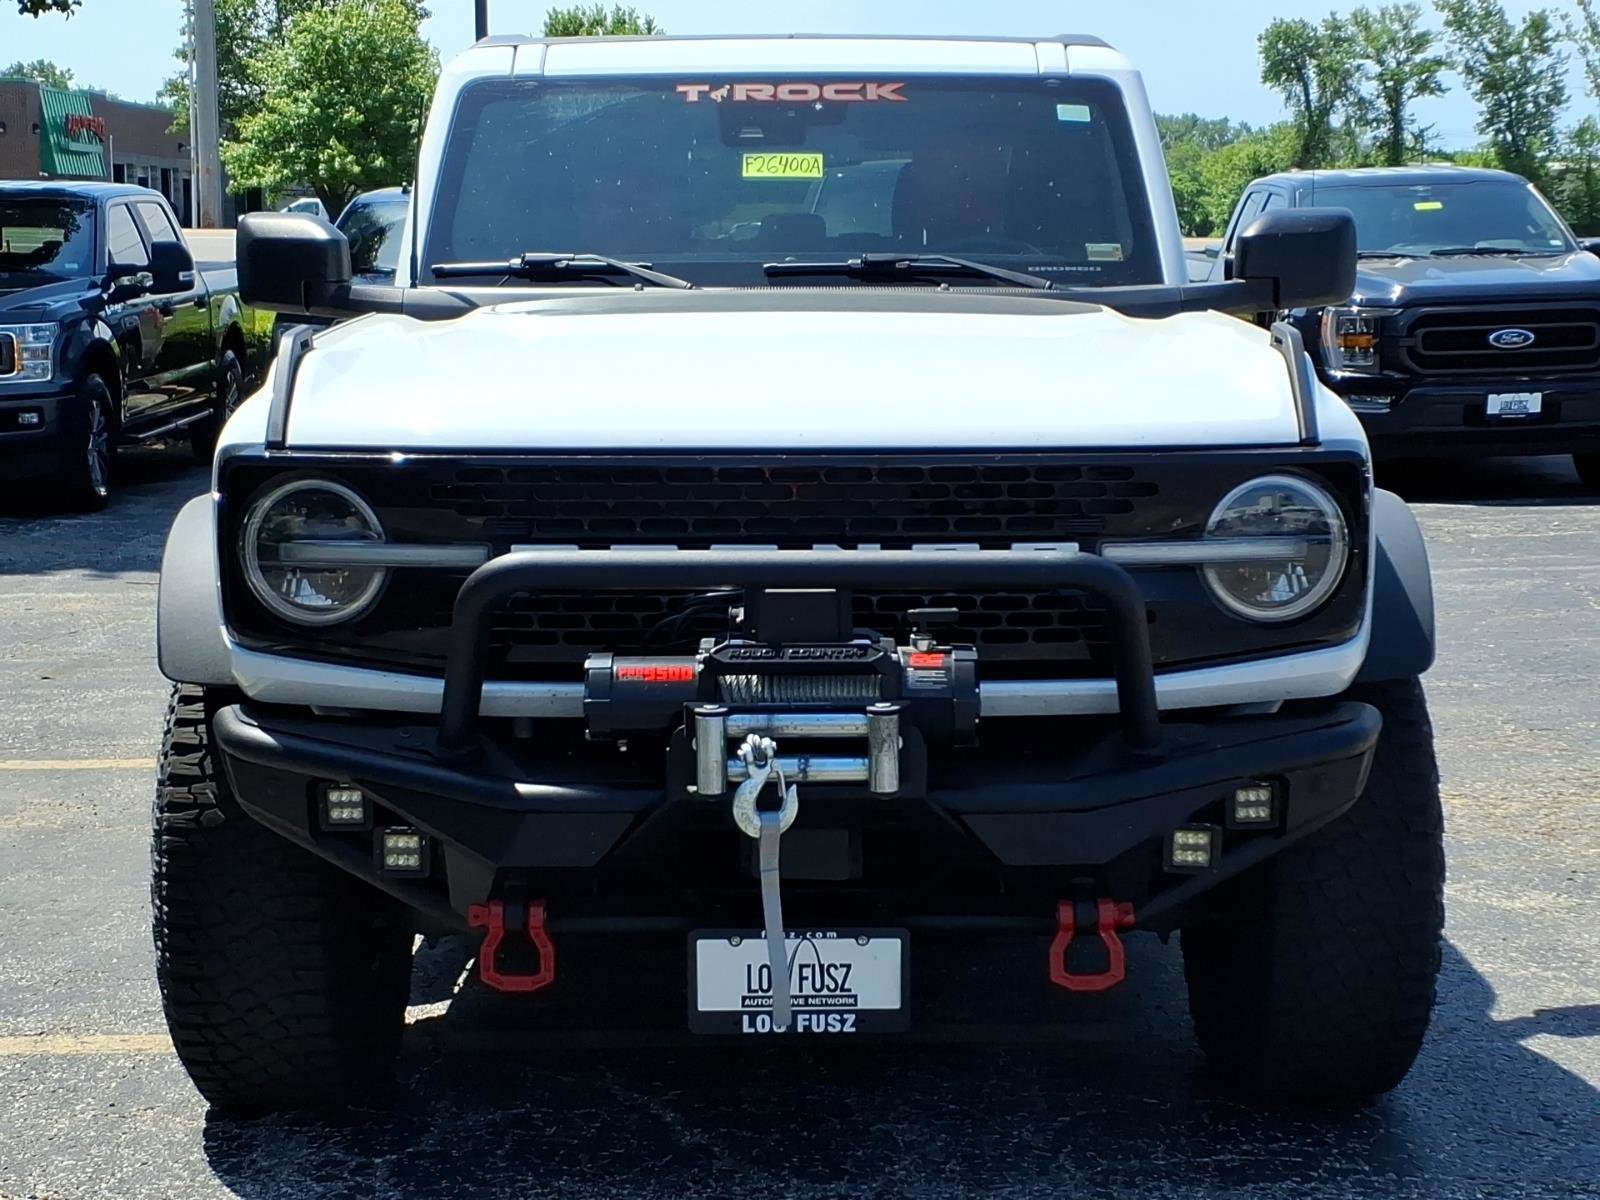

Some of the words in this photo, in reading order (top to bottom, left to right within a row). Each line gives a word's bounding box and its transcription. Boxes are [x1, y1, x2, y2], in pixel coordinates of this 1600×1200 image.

[744, 155, 821, 175] F26400A
[761, 930, 837, 939] fz.com
[747, 963, 786, 994] LO
[798, 963, 852, 994] FUSZ
[744, 997, 805, 1006] AUTOIVE
[808, 996, 856, 1006] NETWORK
[797, 1013, 857, 1033] FUSZ
